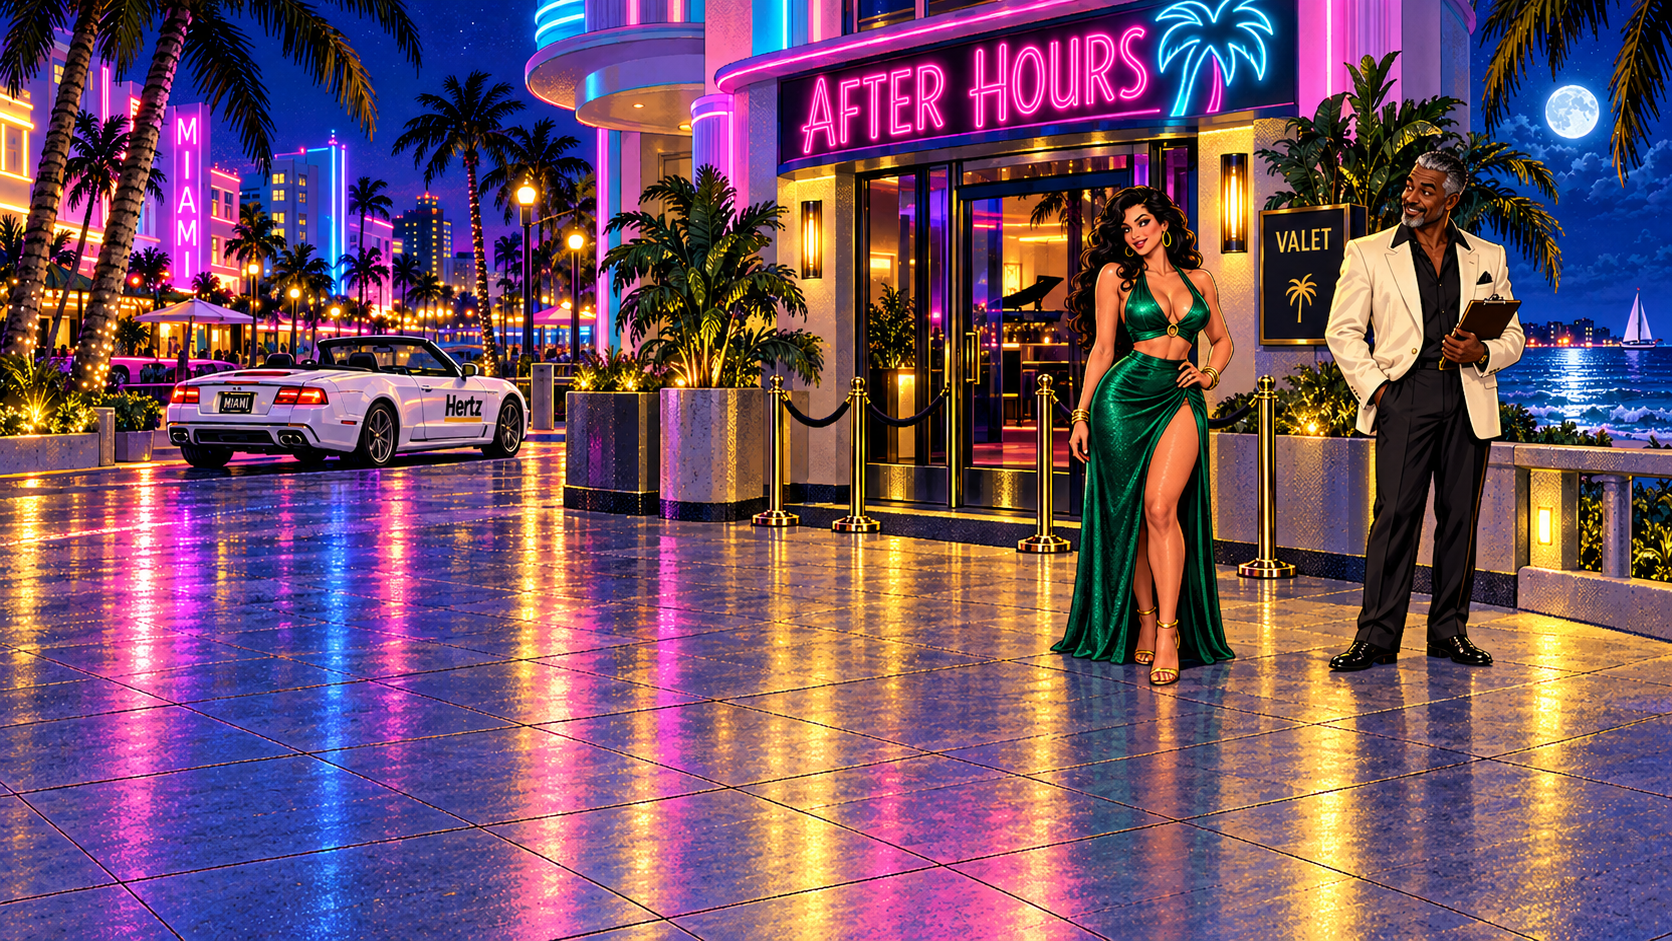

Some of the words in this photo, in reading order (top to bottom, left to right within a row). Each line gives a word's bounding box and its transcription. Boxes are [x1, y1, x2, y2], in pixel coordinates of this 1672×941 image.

[803, 64, 944, 154] AFTER
[969, 27, 1147, 128] HOURS
[177, 117, 197, 278] MIAMI
[1275, 227, 1332, 253] VALET
[445, 394, 483, 417] Hertz
